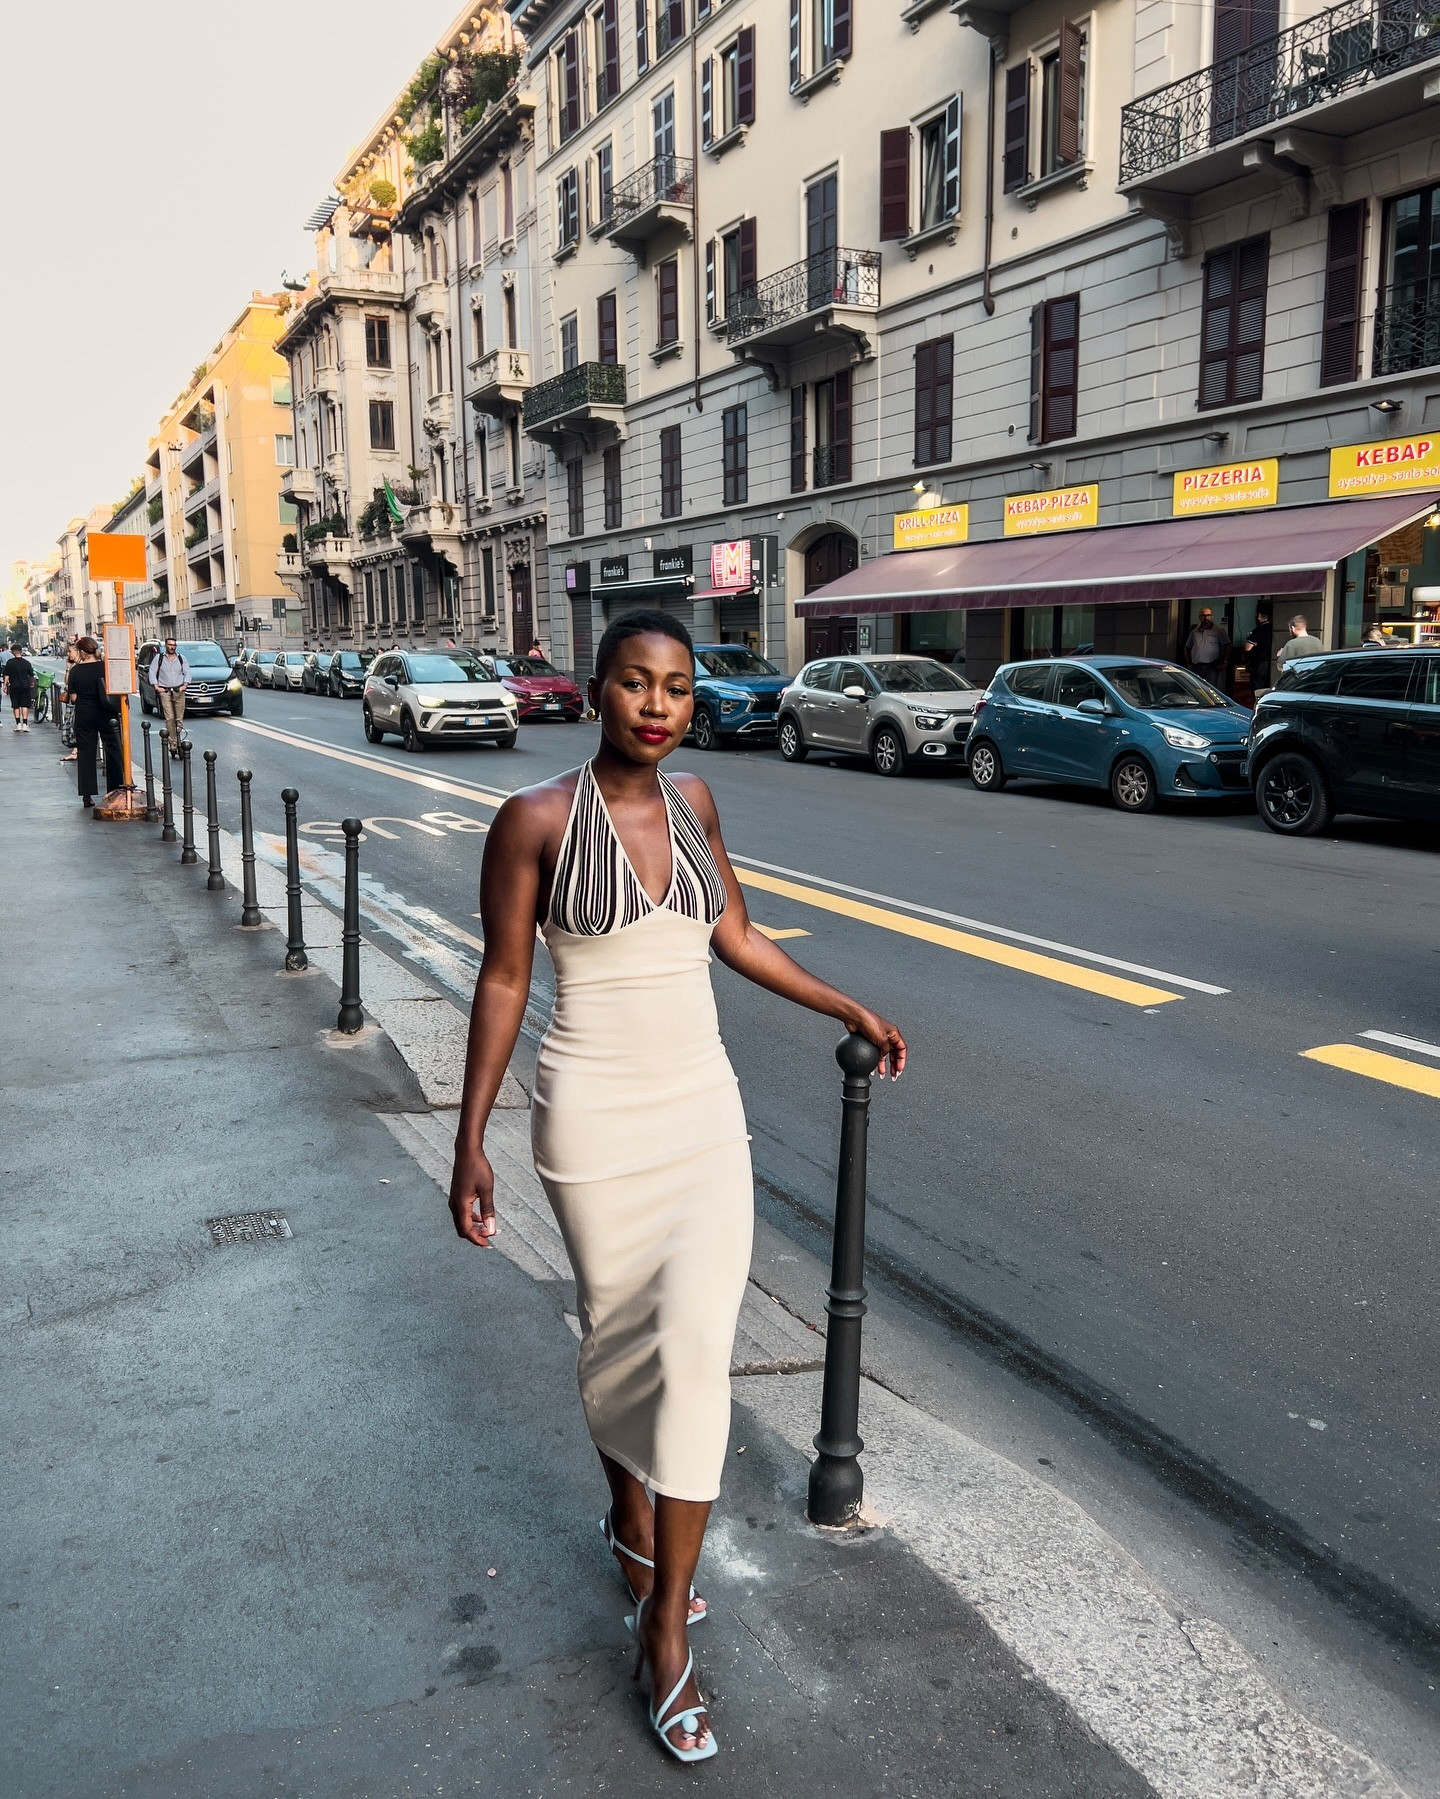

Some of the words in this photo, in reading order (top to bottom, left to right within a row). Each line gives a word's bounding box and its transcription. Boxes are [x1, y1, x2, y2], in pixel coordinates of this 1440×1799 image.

[1356, 441, 1432, 467] KEBAP
[1183, 466, 1263, 490] PIZZERIA
[603, 565, 625, 577] frankie's
[659, 557, 685, 571] frankie's
[298, 811, 490, 843] BUS
